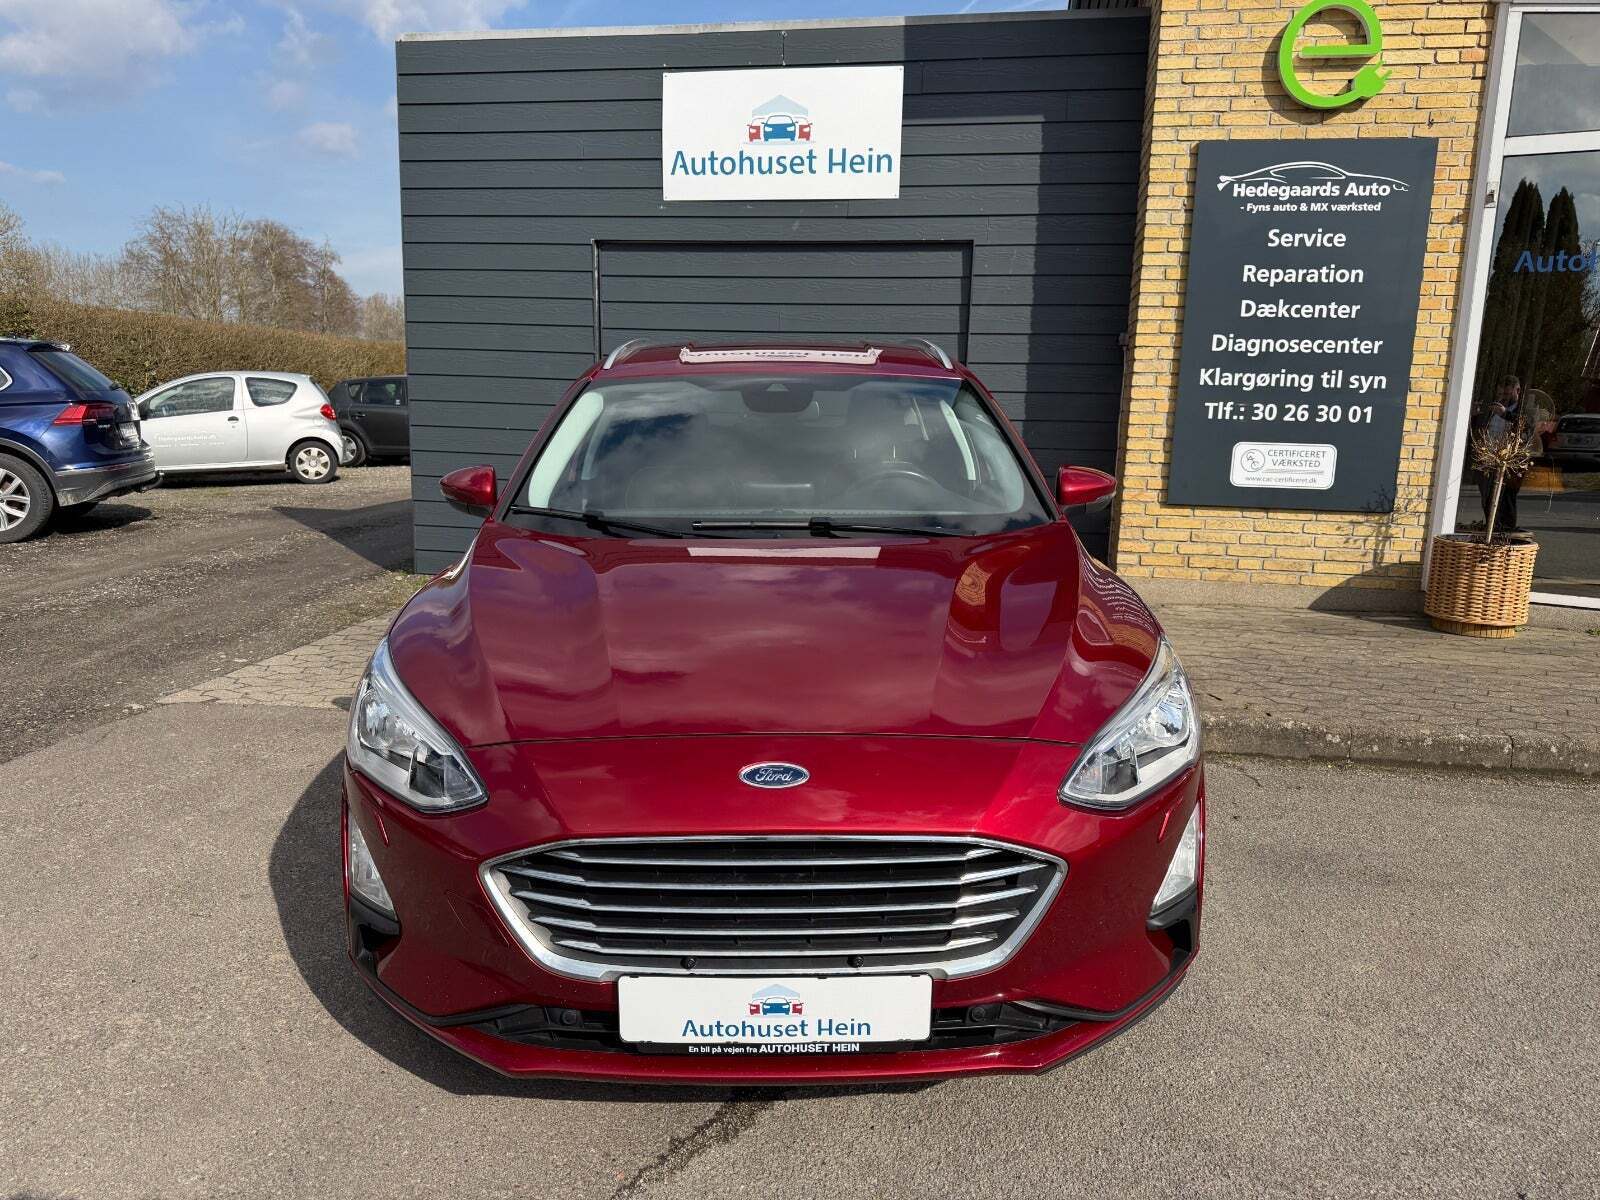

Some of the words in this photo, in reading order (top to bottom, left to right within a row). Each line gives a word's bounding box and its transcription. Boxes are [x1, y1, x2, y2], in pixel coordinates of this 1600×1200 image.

[671, 149, 817, 175] Autohuset
[829, 148, 892, 173] Hein
[1233, 182, 1339, 200] Hedegaards
[1345, 183, 1391, 197] Auto
[1247, 203, 1271, 212] Fyns
[1273, 203, 1297, 211] auto
[1300, 203, 1307, 211] &
[1311, 203, 1328, 211] MX
[1331, 202, 1381, 212] værksted
[1268, 228, 1346, 247] Service
[1243, 264, 1363, 287] Reparation
[1241, 299, 1360, 318] Dækcenter
[1212, 334, 1383, 356] Diagnosecenter
[1200, 368, 1313, 391] Klargøring
[1321, 370, 1342, 388] til
[1349, 375, 1387, 393] syn
[1205, 402, 1245, 420] Tlf.:
[1252, 403, 1277, 421] 30
[1283, 404, 1308, 421] 26
[1316, 405, 1341, 422] 30
[1349, 406, 1373, 423] 01
[1268, 449, 1326, 458] CERTIFICERET
[1272, 459, 1321, 467] VÆRKSTED
[755, 768, 793, 781] Ford
[682, 1020, 808, 1037] Autohuset
[818, 1019, 871, 1035] Hein
[711, 1046, 721, 1054] på
[724, 1046, 744, 1055] vejen
[759, 1044, 829, 1053] AUTOHUSET
[833, 1044, 859, 1052] HEIN
